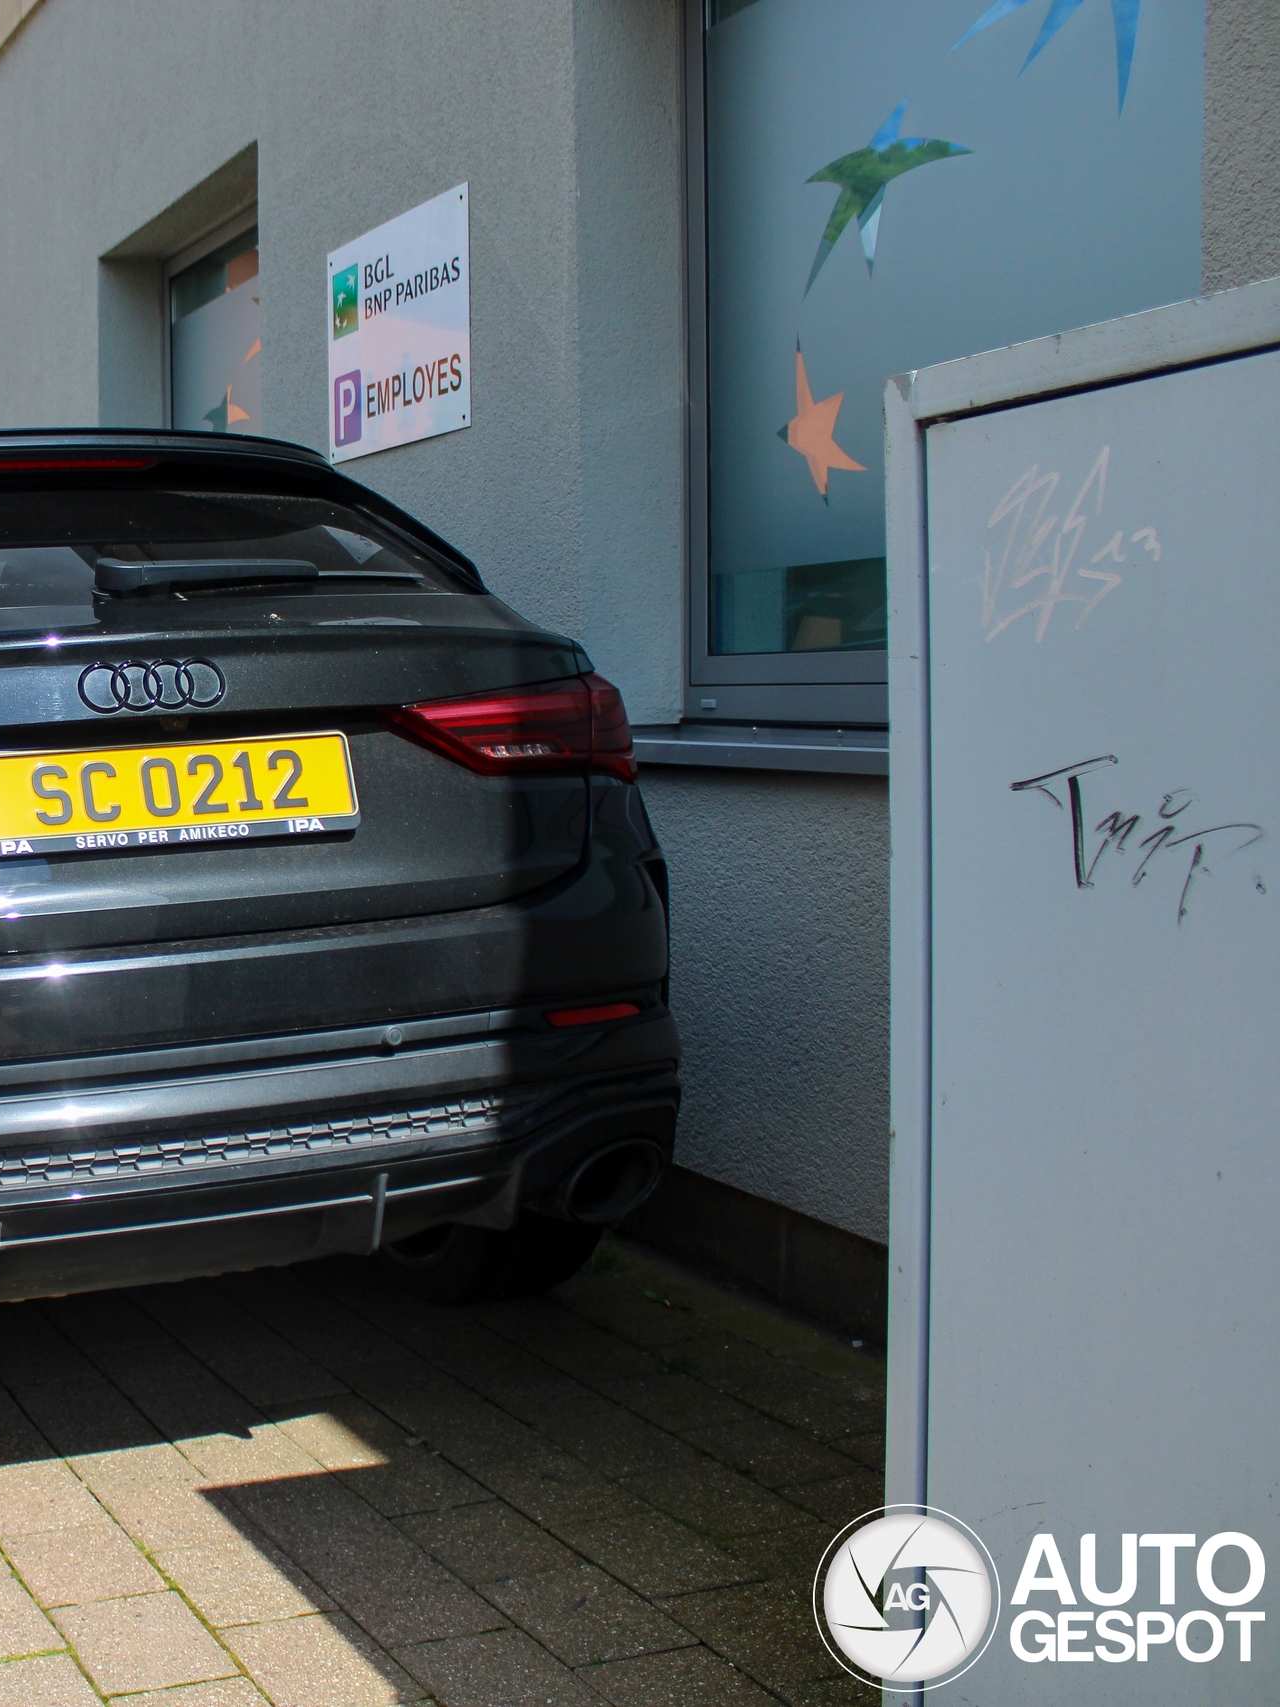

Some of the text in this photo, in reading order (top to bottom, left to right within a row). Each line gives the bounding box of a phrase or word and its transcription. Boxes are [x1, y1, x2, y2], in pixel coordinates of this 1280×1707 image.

[364, 255, 395, 290] BGL
[364, 257, 461, 320] BNP PARIBAS
[339, 353, 463, 440] P EMPLOYES
[31, 749, 310, 826] SC 0212
[76, 823, 250, 849] SERVO PER AMIKECO
[288, 818, 325, 834] IPA
